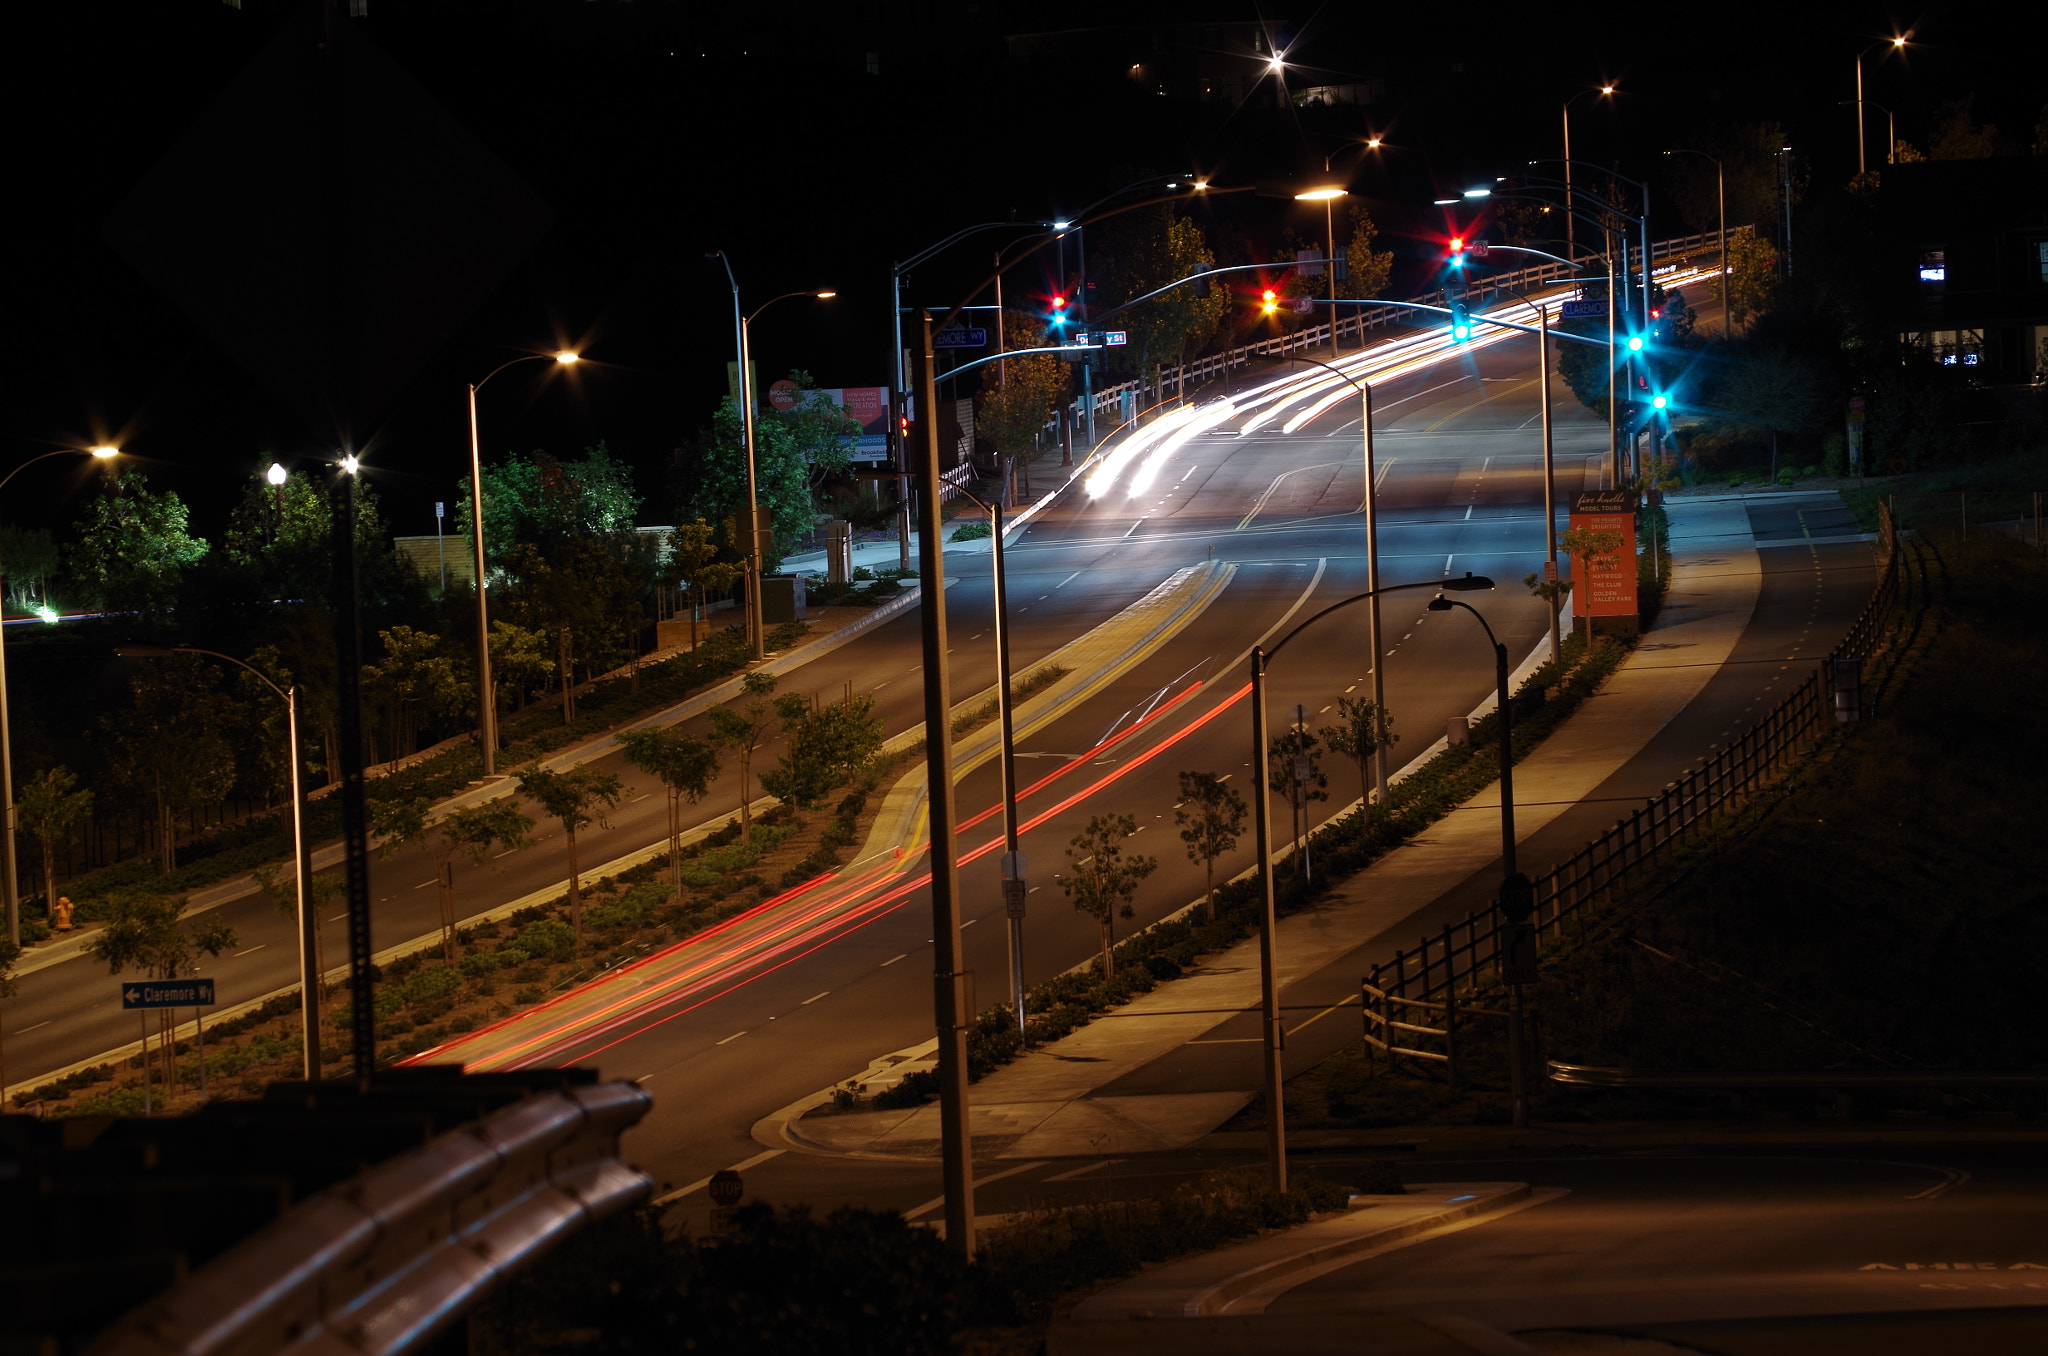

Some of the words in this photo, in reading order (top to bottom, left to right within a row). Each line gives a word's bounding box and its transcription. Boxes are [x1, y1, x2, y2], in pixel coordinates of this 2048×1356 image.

[970, 331, 983, 340] WY
[1114, 334, 1123, 342] St
[144, 986, 195, 1002] Claremore
[198, 984, 213, 1003] Wy
[710, 1181, 741, 1197] STOP
